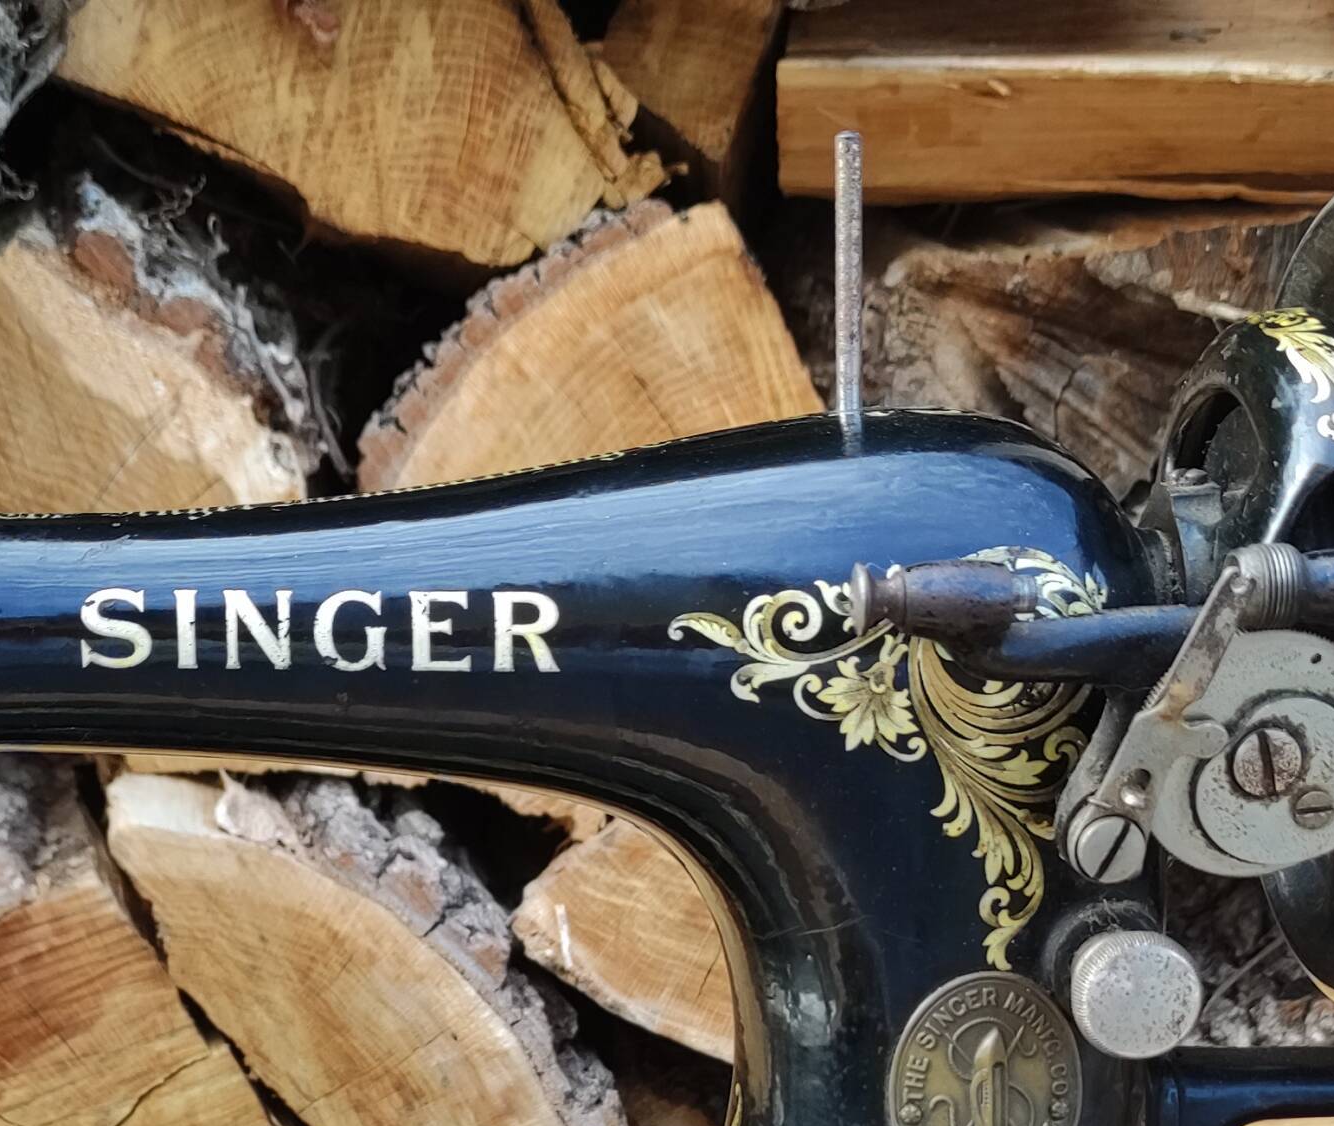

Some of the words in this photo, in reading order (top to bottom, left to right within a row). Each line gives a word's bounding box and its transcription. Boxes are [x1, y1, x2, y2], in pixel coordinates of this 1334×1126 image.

[80, 588, 561, 673] SINGER
[902, 1055, 929, 1101] THE
[916, 987, 998, 1050] SINGER
